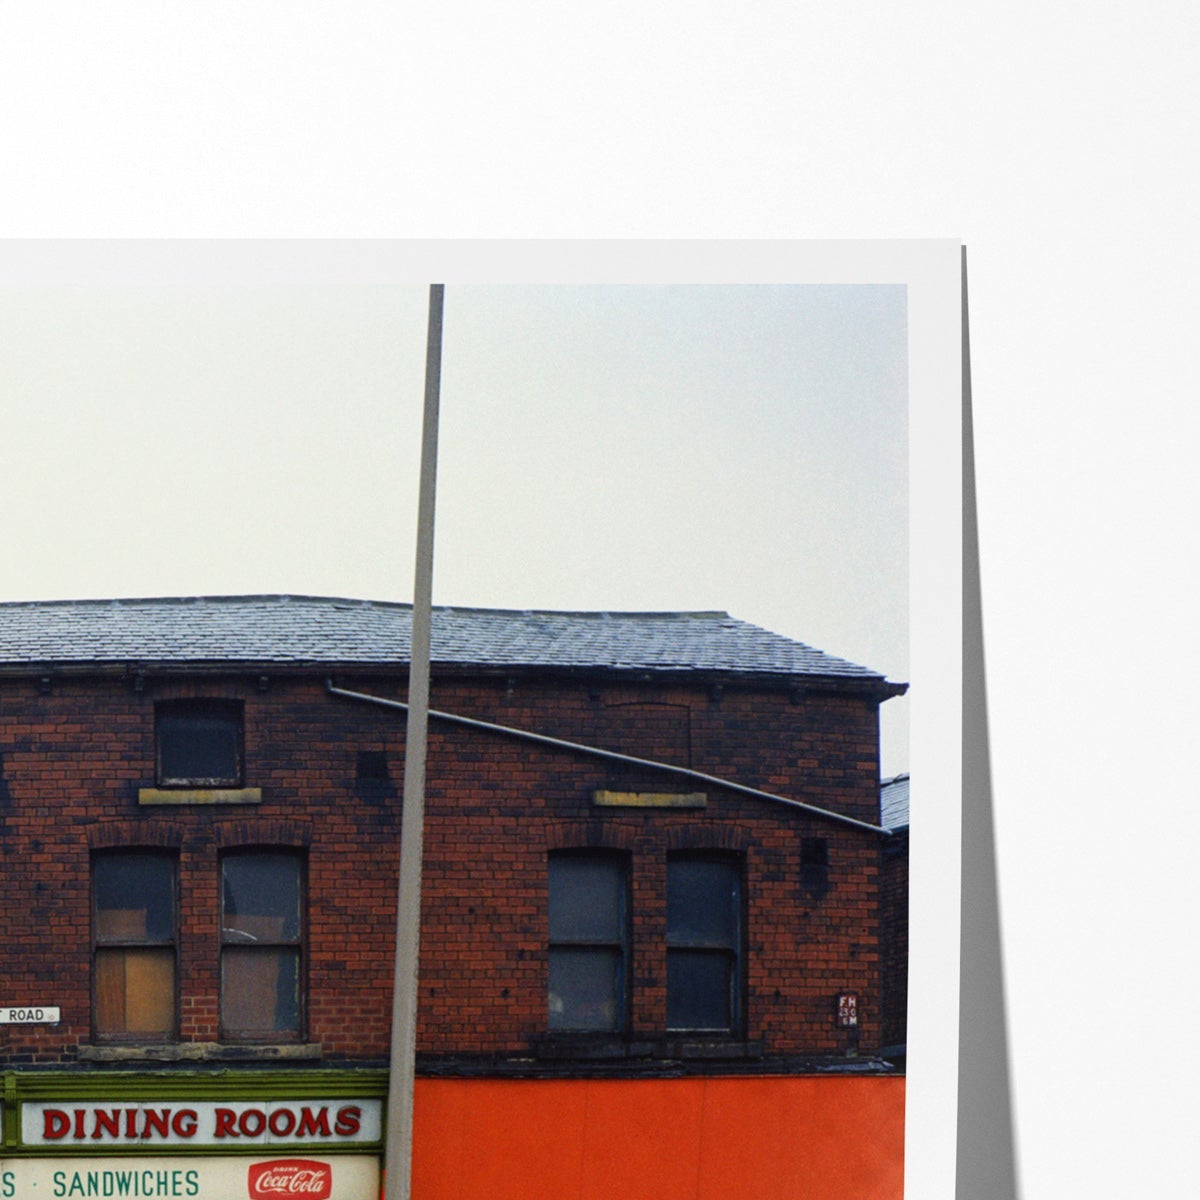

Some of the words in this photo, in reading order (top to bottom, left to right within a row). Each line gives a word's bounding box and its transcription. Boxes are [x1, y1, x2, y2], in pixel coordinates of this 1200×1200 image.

[9, 1009, 44, 1022] ROAD
[42, 1108, 199, 1139] DINING
[213, 1106, 362, 1138] ROOMS
[53, 1170, 199, 1198] SANDWICHES
[255, 1170, 326, 1193] Coca-Cola
